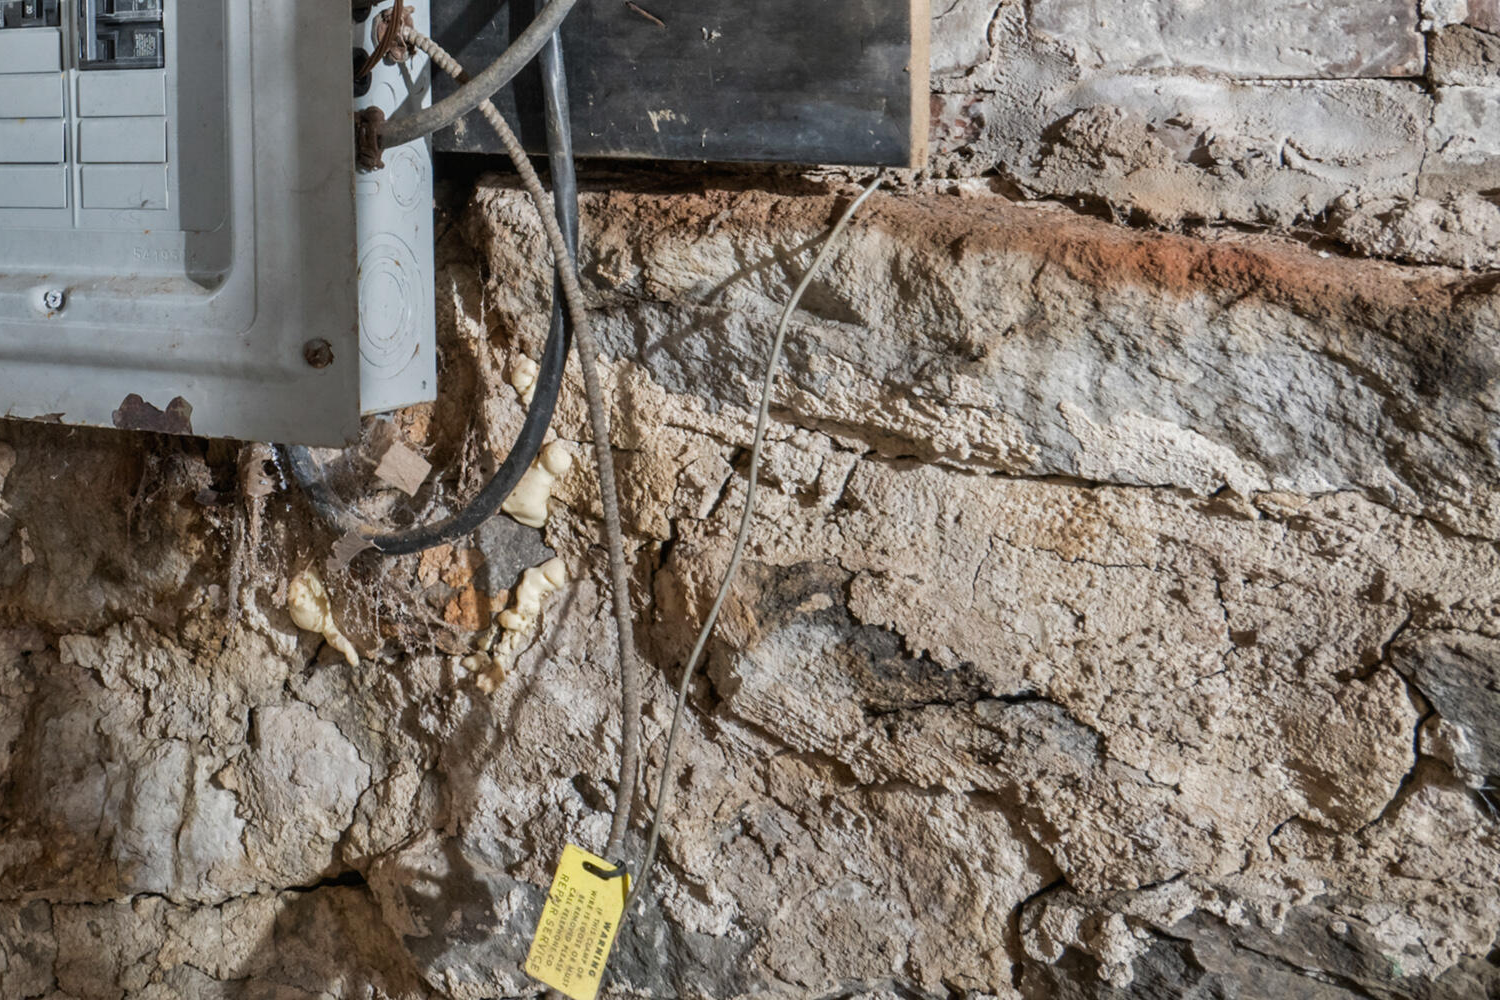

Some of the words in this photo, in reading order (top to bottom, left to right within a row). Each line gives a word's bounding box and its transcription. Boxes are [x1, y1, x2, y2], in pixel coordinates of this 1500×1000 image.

[549, 873, 569, 915] REPAIR
[565, 886, 576, 906] CALL
[577, 894, 585, 904] BE
[586, 890, 598, 909] WIRE
[582, 911, 591, 920] IS
[595, 907, 603, 916] IF
[549, 908, 569, 951] TELEPHONE
[564, 906, 582, 943] REMOVED
[573, 921, 588, 949] LOOSE
[589, 918, 600, 935] THIS
[529, 918, 553, 972] SERVICE
[568, 950, 578, 962] OR
[579, 937, 594, 965] CLAMP
[587, 921, 611, 978] WARNING
[554, 944, 570, 972] PLEASE
[561, 965, 574, 987] MUST
